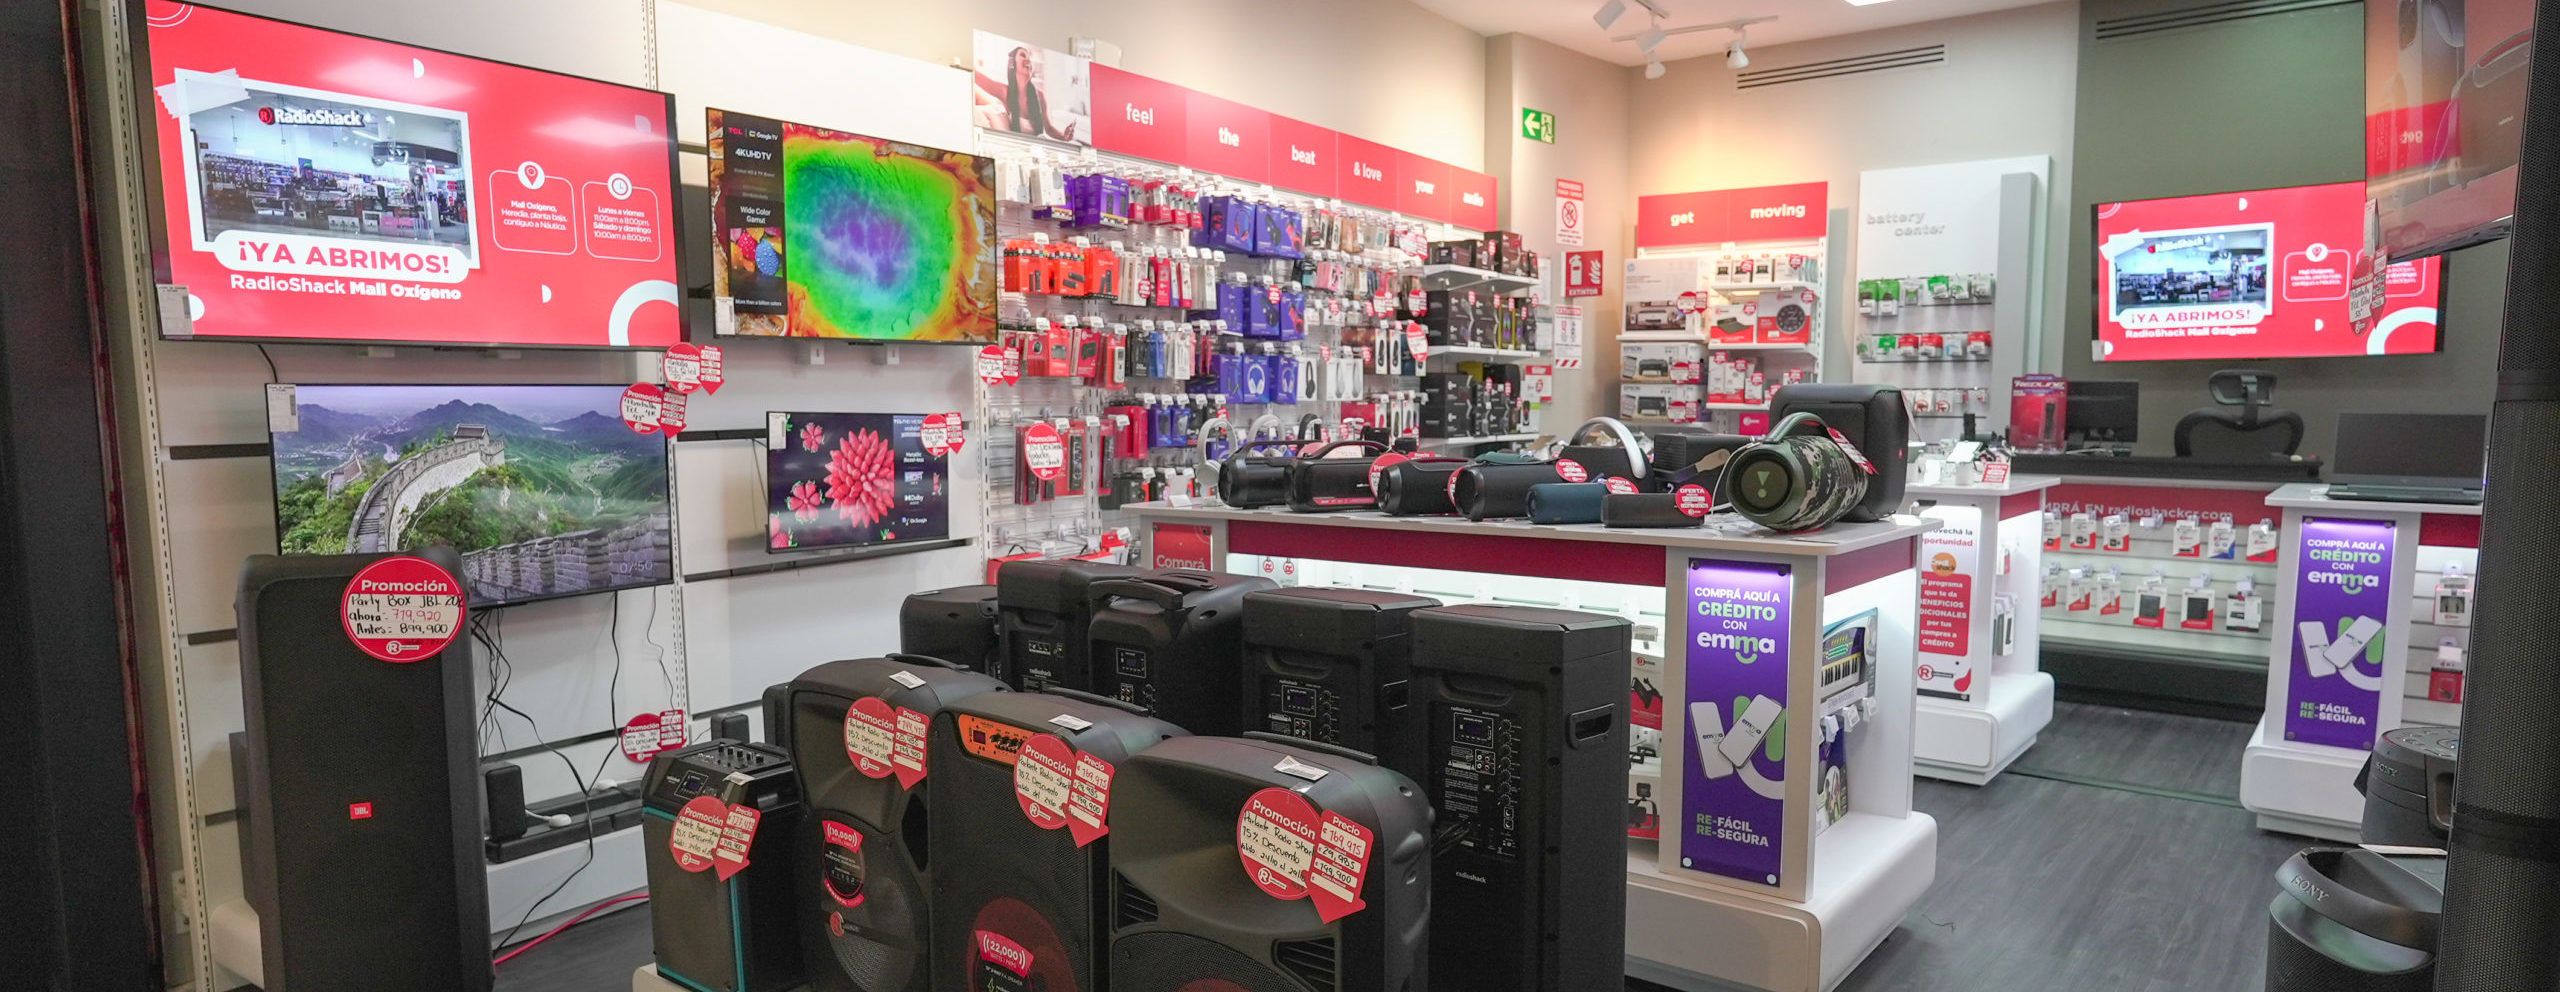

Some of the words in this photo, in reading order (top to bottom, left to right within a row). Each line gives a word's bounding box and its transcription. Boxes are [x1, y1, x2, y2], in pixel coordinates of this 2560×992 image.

[274, 108, 364, 127] RadioShack
[1126, 102, 1153, 126] feel
[728, 126, 744, 135] TCL
[756, 132, 772, 141] Google
[1218, 127, 1240, 147] the
[1291, 145, 1316, 166] beat
[1353, 161, 1361, 176] &
[1362, 163, 1382, 181] love
[1415, 179, 1435, 195] your
[740, 205, 755, 215] Wide
[755, 207, 771, 216] Color
[1670, 211, 1695, 227] get
[1750, 203, 1806, 219] moving
[1866, 210, 1926, 225] battery
[746, 215, 766, 224] Gamut
[1894, 224, 1946, 237] center
[238, 240, 296, 265] ¡YA
[305, 245, 450, 274] ABRIMOS!
[230, 273, 346, 295] RadioShack
[349, 280, 387, 297] Mall
[390, 283, 462, 301] Oxígeno
[2131, 313, 2159, 324] ¡YA
[2165, 309, 2251, 322] ABRIMOS!
[2125, 328, 2186, 338] RadioShack
[2187, 326, 2210, 337] Mall
[668, 352, 700, 361] Promoción
[627, 390, 662, 402] Promoción
[2043, 500, 2080, 514] MPRÁ
[2085, 503, 2104, 514] EN
[1921, 537, 1974, 547] portunidad
[2307, 538, 2350, 549] COMPRÁ
[2351, 539, 2376, 551] AQUÍ
[2376, 542, 2386, 551] A
[1156, 554, 1206, 570] Comprá
[2309, 547, 2382, 564] CRÉDITO
[2331, 562, 2354, 571] CON
[361, 579, 448, 592] Promoción
[1928, 580, 1963, 588] programa
[2307, 570, 2379, 588] emma
[1694, 586, 1742, 601] COMPRÁ
[1743, 588, 1771, 603] AQUÍ
[1771, 592, 1781, 604] A
[1924, 589, 1938, 597] que
[1948, 590, 1957, 598] da
[351, 594, 381, 612] Party
[387, 595, 412, 607] Box
[420, 595, 442, 608] JBL
[1696, 599, 1777, 622] CRÉDITO
[1920, 599, 1965, 609] ENEFICIOS
[1920, 608, 1967, 619] DICIONALES
[399, 623, 448, 635] 899,900
[1722, 620, 1748, 631] CON
[1926, 620, 1940, 628] por
[1940, 620, 1952, 628] tus
[1920, 629, 1951, 639] compras
[1696, 631, 1776, 655] emma
[1922, 638, 1955, 648] CRÉDITO
[902, 710, 922, 722] Precio
[2300, 701, 2352, 715] RE-FÁCIL
[852, 708, 895, 731] Promoción
[2300, 710, 2367, 725] RE-SEGURA
[1025, 744, 1073, 777] Promoción
[1084, 755, 1105, 771] Precio
[2376, 761, 2399, 777] SONY
[1031, 775, 1059, 797] Descuento
[355, 806, 369, 816] JBL
[684, 807, 724, 827] Promoción
[735, 806, 753, 817] Precio
[1252, 799, 1317, 840] Promoción
[1332, 816, 1361, 836] Precio
[1696, 812, 1753, 833] RE-FÁCIL
[1274, 826, 1292, 846] Radio
[1696, 824, 1769, 847] RE-SEGURA
[1242, 825, 1259, 843] 15%
[1261, 836, 1300, 864] Descuento
[1321, 845, 1356, 871] 29,985
[1455, 870, 1488, 884] radioshack
[2292, 871, 2330, 902] SONY
[990, 940, 1019, 960] 22,000
